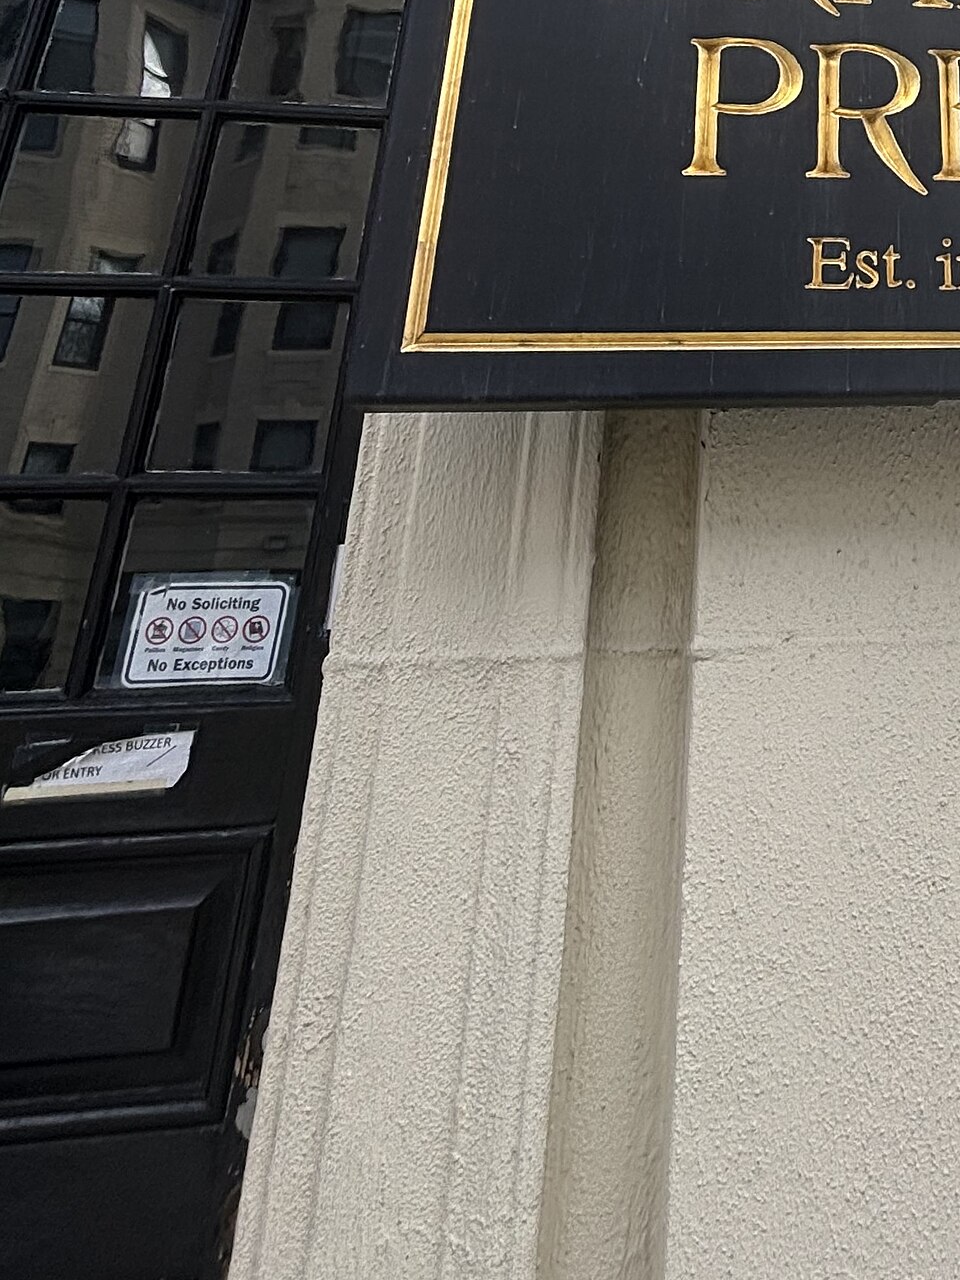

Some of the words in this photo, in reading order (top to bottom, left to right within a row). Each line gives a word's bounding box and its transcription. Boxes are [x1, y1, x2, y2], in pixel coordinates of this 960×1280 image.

[804, 236, 917, 290] Est.
[166, 597, 187, 612] No
[191, 596, 262, 612] Soliciting
[147, 658, 168, 672] No
[173, 657, 254, 673] Exceptions
[92, 740, 122, 755] RESS
[125, 737, 172, 752] BUZZER
[63, 765, 103, 780] ENTRY
